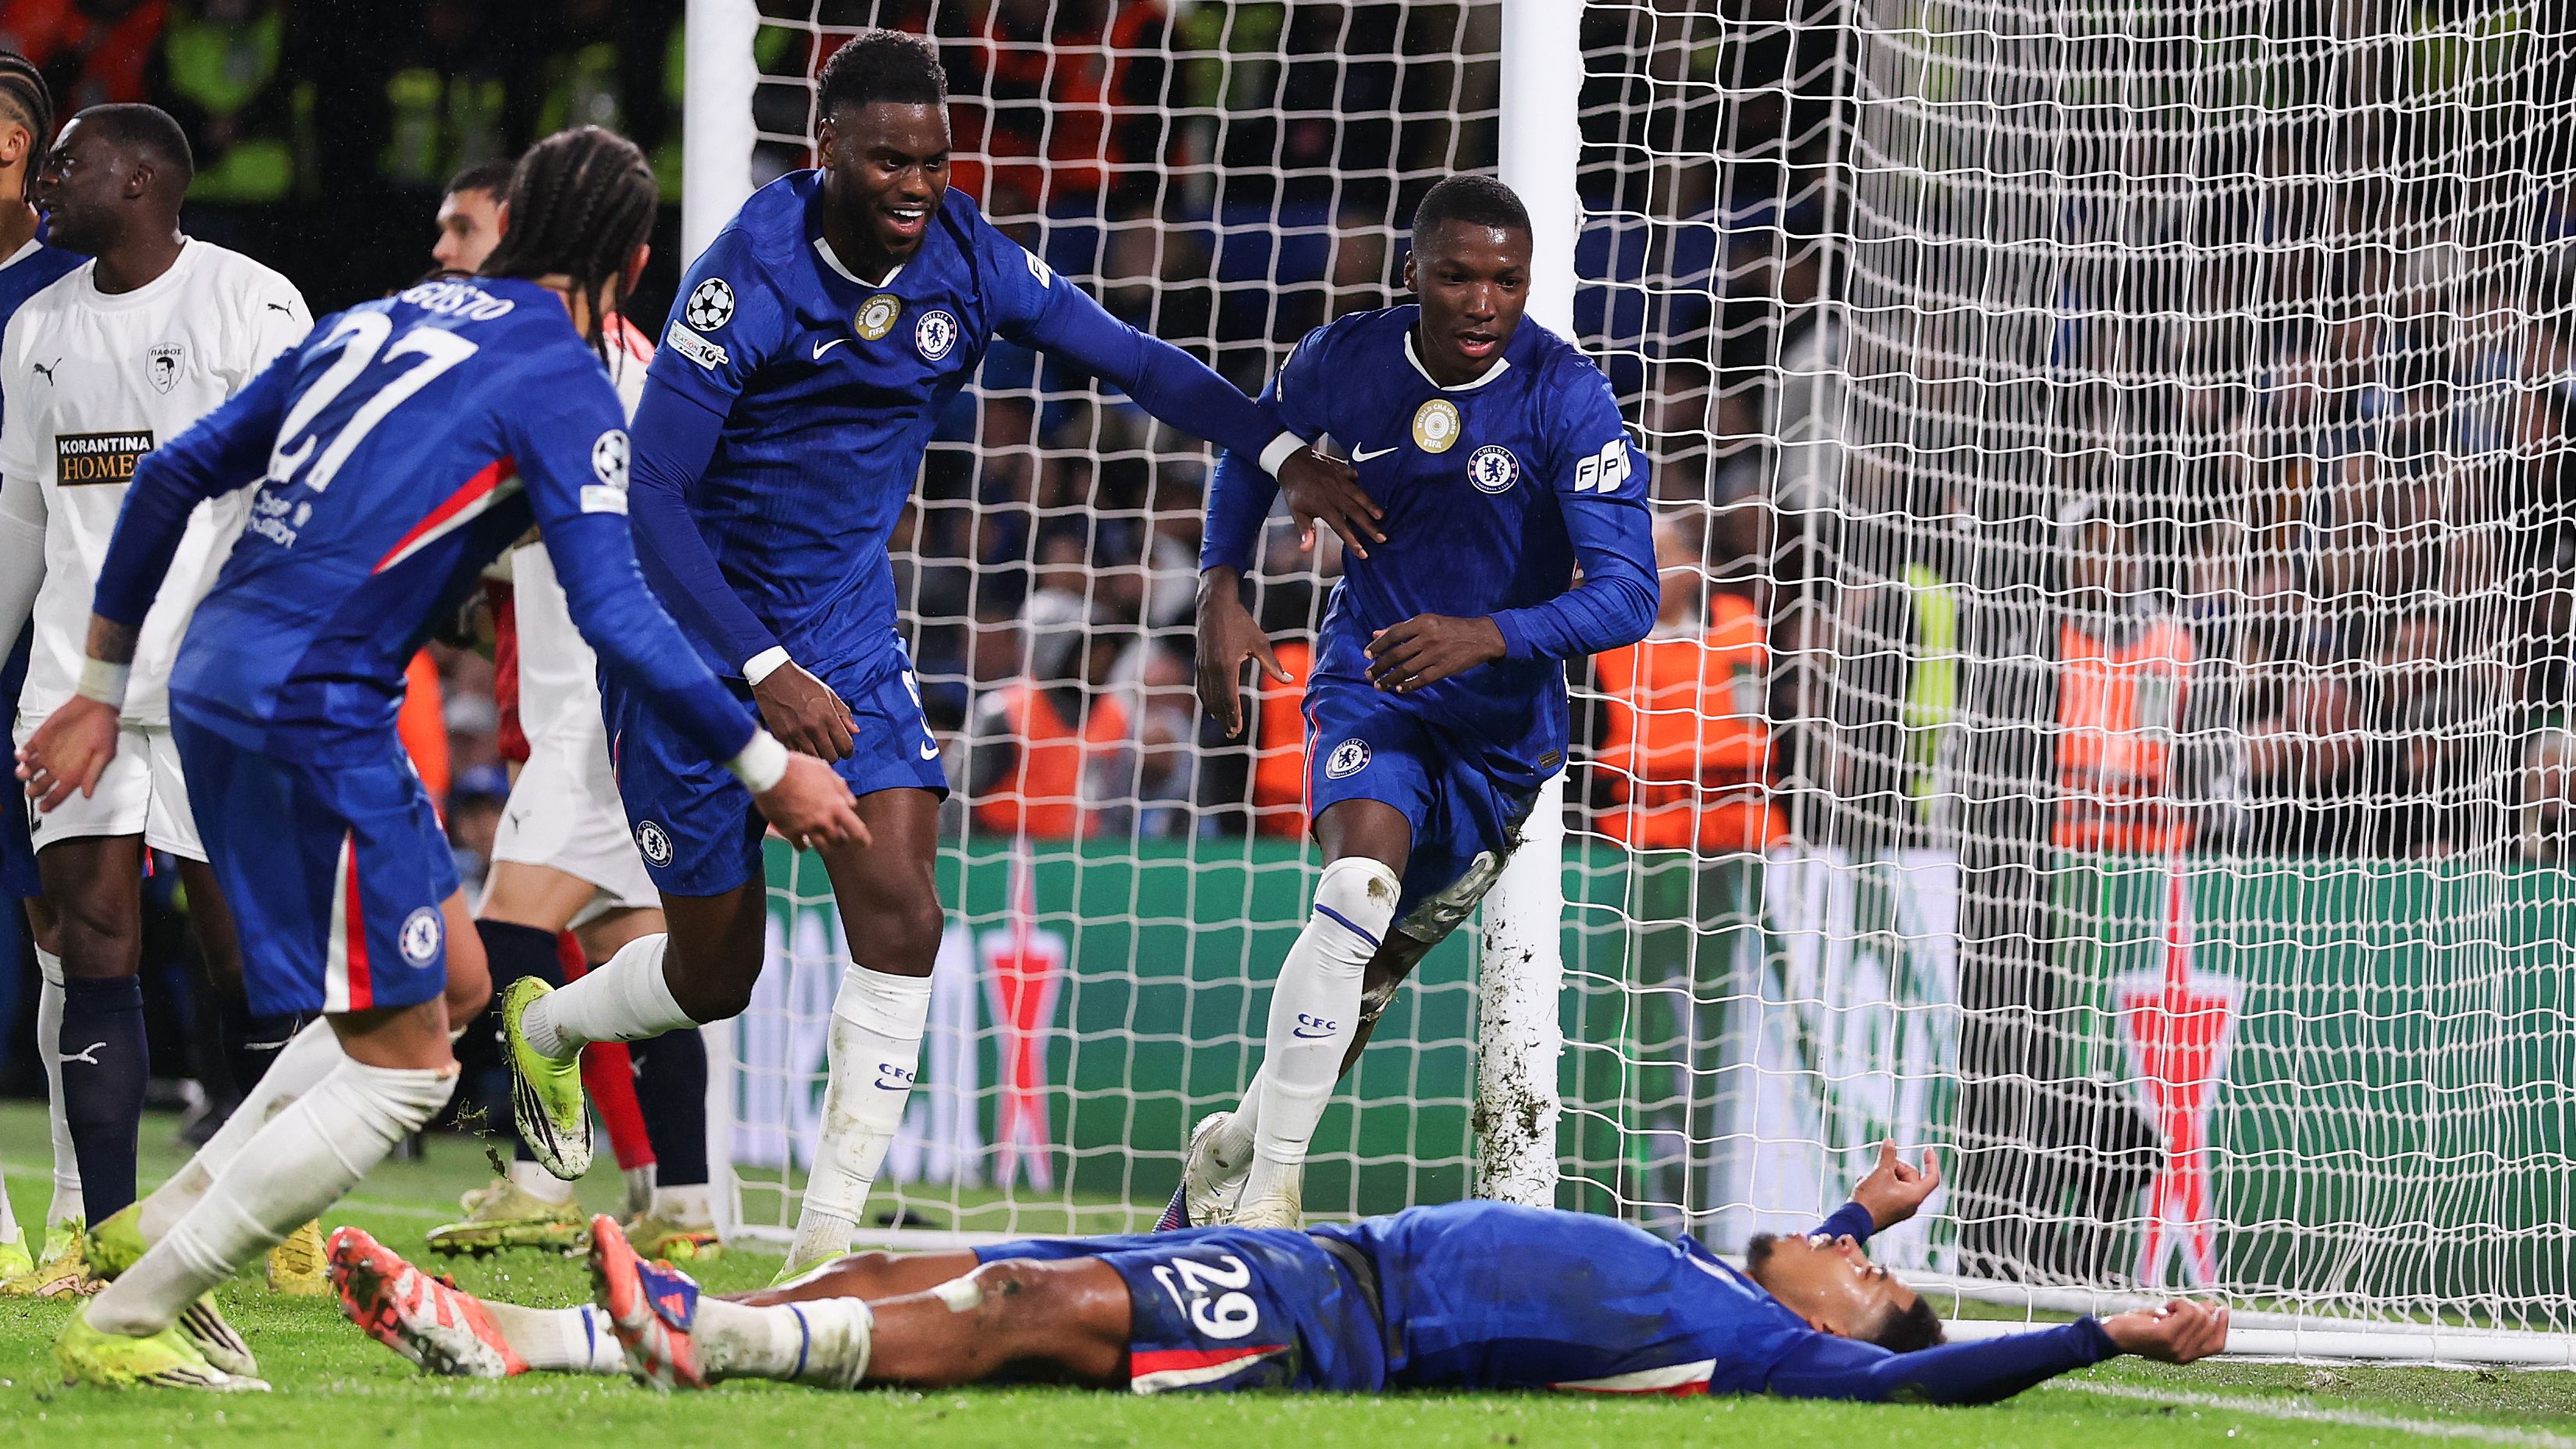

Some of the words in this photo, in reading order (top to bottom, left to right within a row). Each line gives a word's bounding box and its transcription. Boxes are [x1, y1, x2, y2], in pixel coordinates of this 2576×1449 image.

[401, 282, 515, 321] GUSTO
[921, 313, 949, 326] CHELSEA
[868, 326, 885, 337] FIFA
[267, 312, 479, 493] 27
[1417, 406, 1432, 429] WORLD
[60, 436, 151, 454] KORANTINA
[1423, 439, 1441, 449] FIFA
[1477, 447, 1510, 459] CHELSEA
[1298, 1013, 1336, 1030] CFC
[878, 1063, 914, 1083] CFC
[1171, 1255, 1259, 1340] 29
